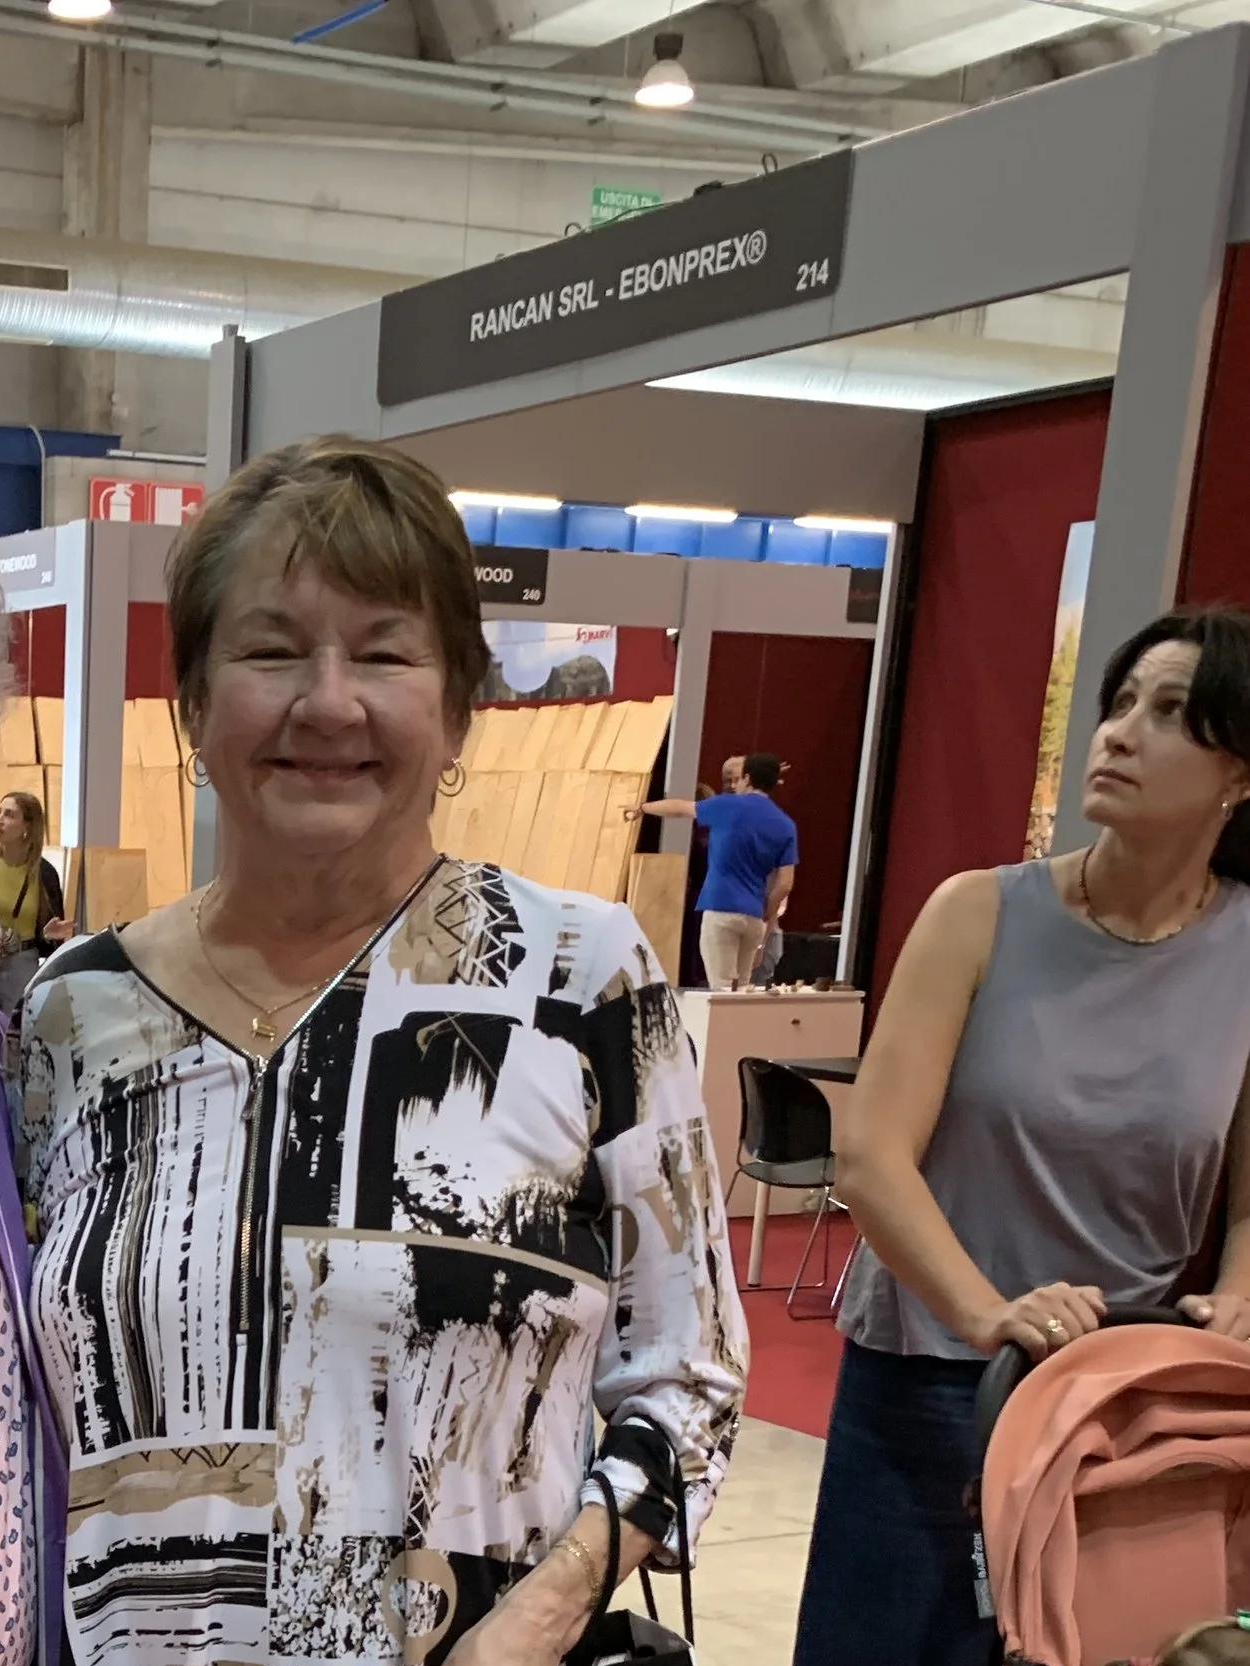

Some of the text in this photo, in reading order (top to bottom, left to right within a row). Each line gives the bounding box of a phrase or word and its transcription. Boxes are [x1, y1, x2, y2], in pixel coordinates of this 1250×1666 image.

[470, 230, 768, 341] RANCAN SRL - EBONPREX®
[796, 258, 830, 292] 214
[522, 589, 541, 601] 240
